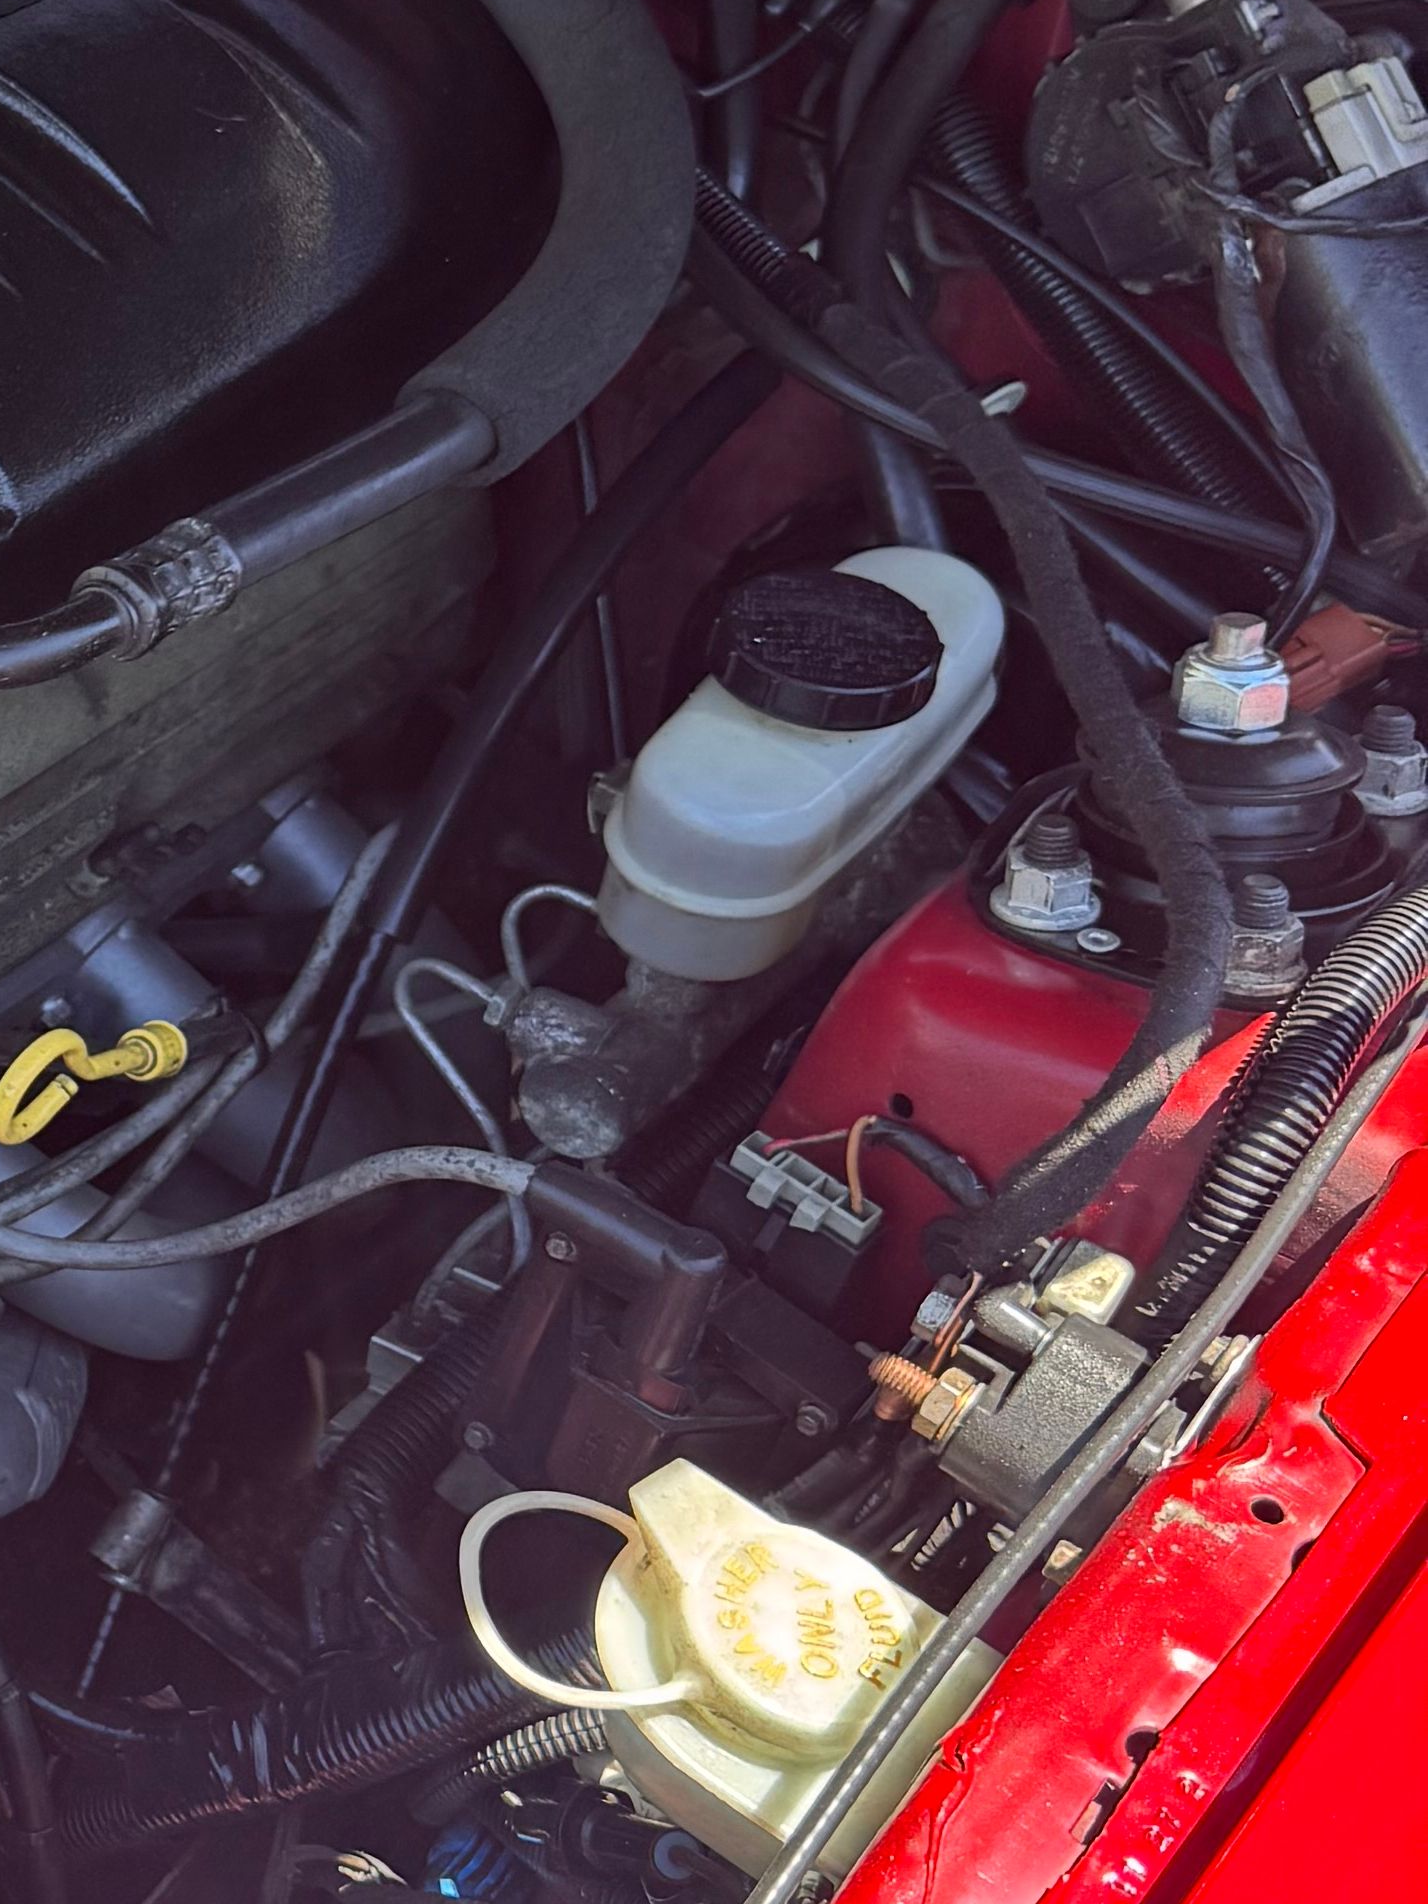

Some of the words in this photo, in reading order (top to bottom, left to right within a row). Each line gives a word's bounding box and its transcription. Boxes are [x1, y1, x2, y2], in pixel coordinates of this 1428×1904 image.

[714, 1540, 784, 1690] WASHER
[792, 1566, 839, 1680] ONLY
[852, 1587, 903, 1692] FLUID
